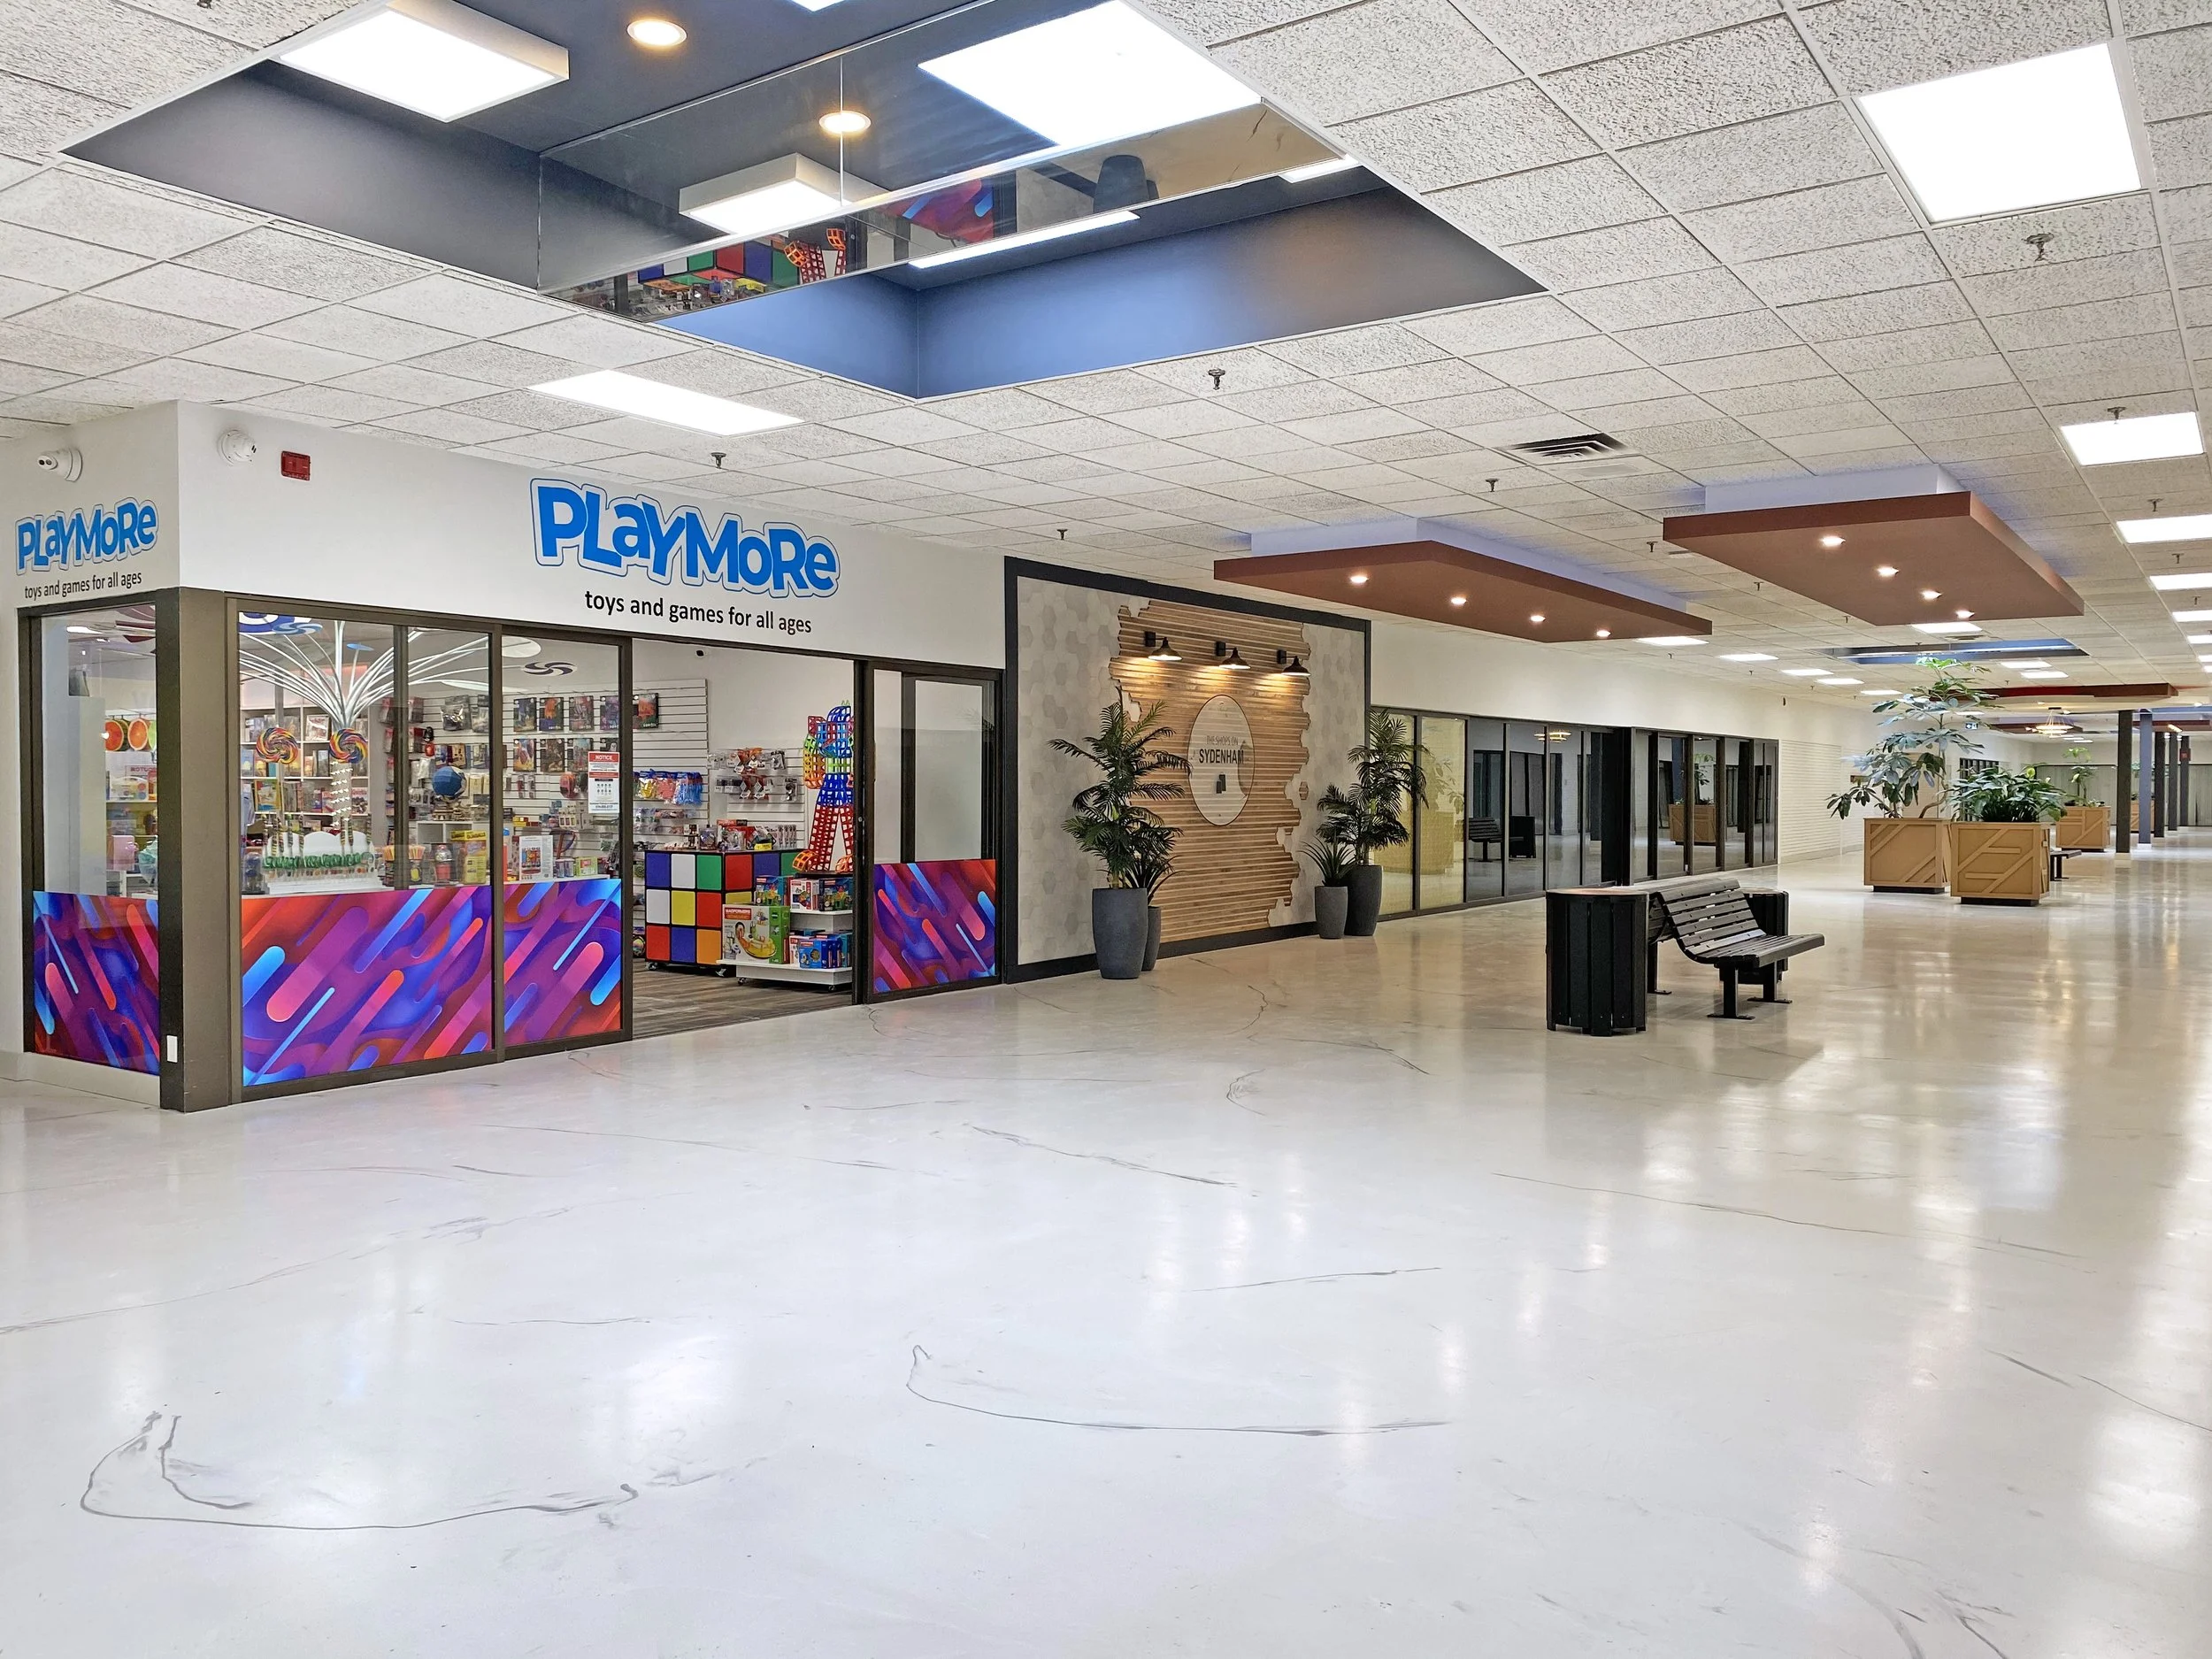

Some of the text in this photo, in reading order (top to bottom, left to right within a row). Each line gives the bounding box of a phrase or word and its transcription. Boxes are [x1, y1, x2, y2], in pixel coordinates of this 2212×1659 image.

[25, 572, 142, 601] toys and games for all ages
[585, 590, 811, 635] toys and games for all ages
[1206, 735, 1239, 746] THE SHOPS ON
[1199, 749, 1244, 764] SYDENHAM
